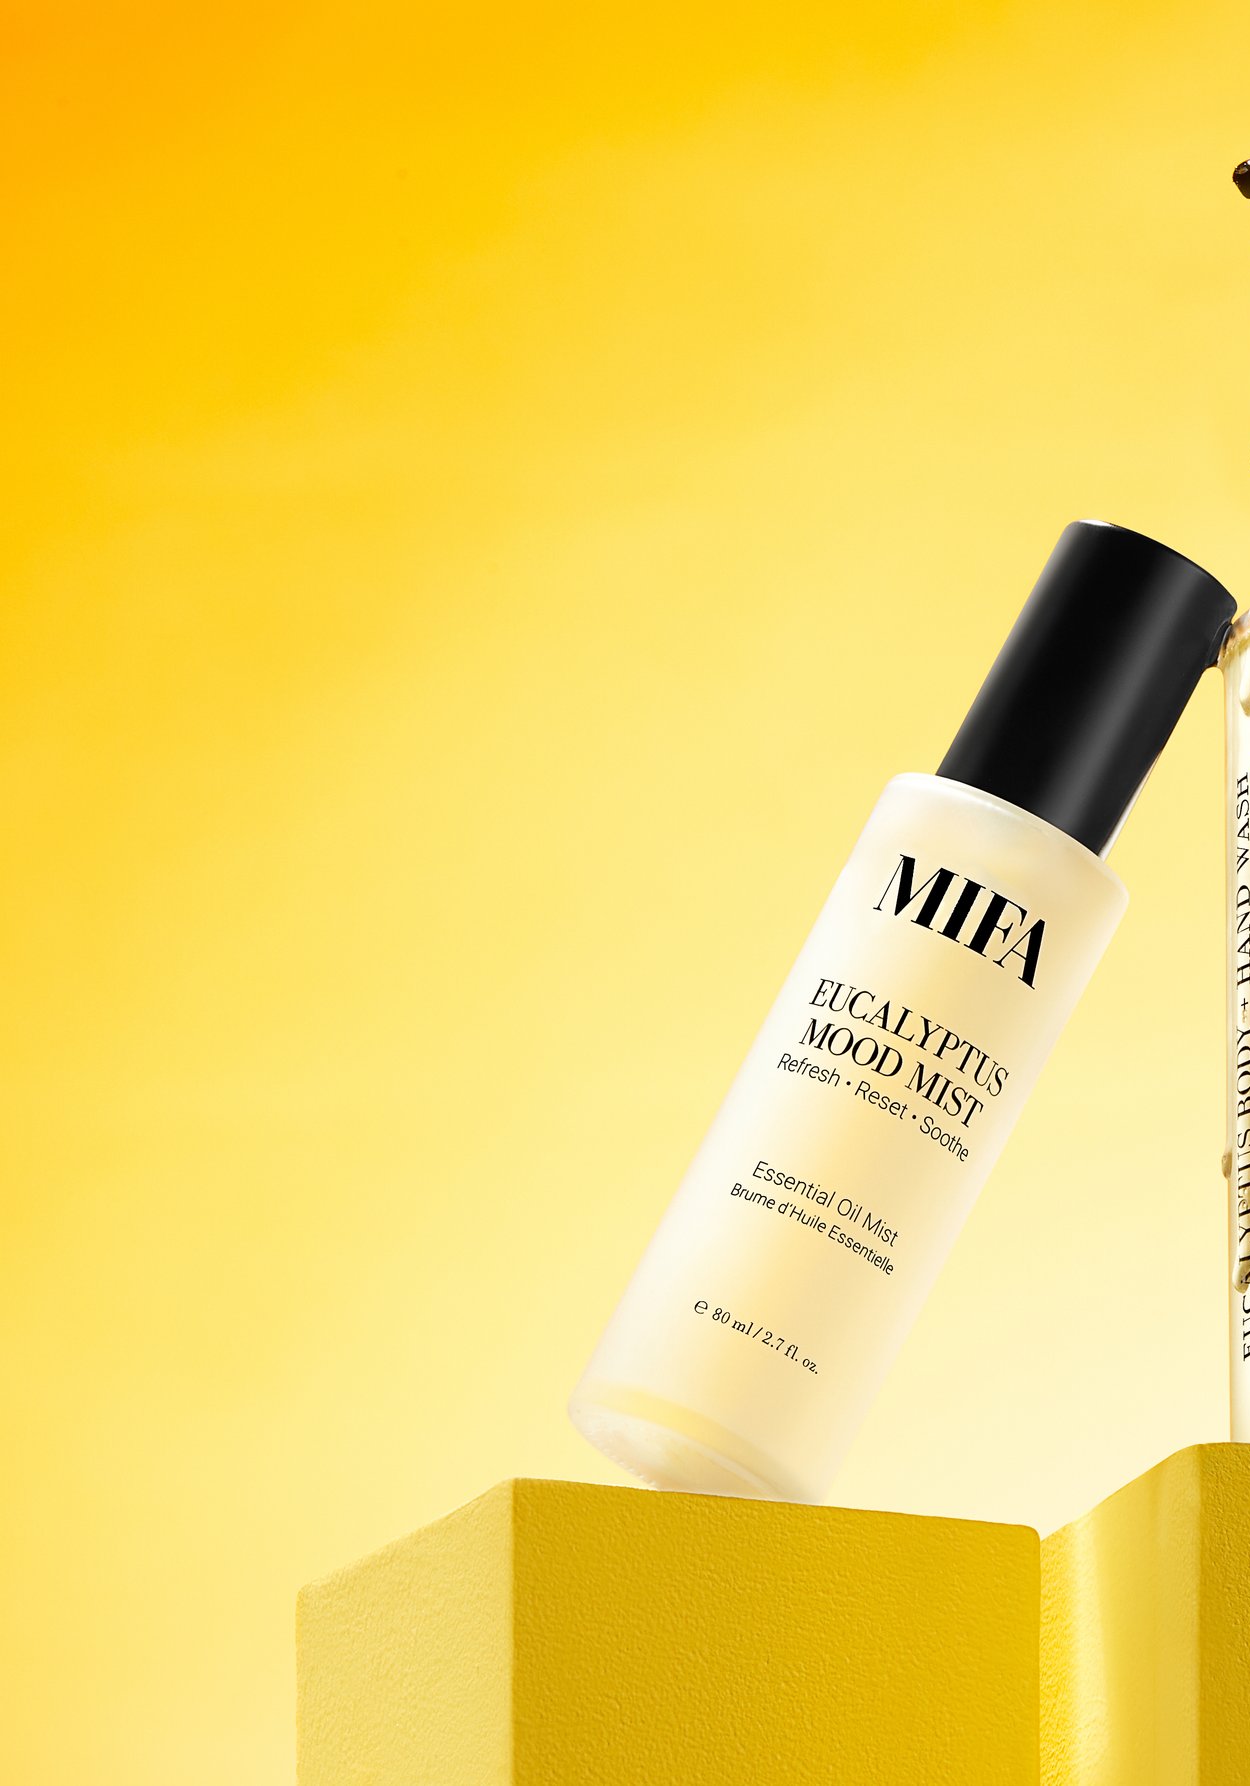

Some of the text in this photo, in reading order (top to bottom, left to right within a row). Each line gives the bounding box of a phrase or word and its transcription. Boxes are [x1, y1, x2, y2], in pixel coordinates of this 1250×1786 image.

[1236, 771, 1250, 876] WASH
[873, 853, 1048, 989] MIFA
[799, 1017, 984, 1128] MOOD MIST
[809, 978, 1010, 1097] EUCALYPTUS
[777, 1052, 970, 1162] Refresh Reset Soothe
[730, 1182, 895, 1276] Brume d'Huile Essentielle
[752, 1160, 899, 1248] Essential Oil Mist
[712, 1307, 731, 1325] 80
[761, 1330, 785, 1351] 2.7
[784, 1344, 799, 1362] fl.
[802, 1358, 819, 1375] oz.
